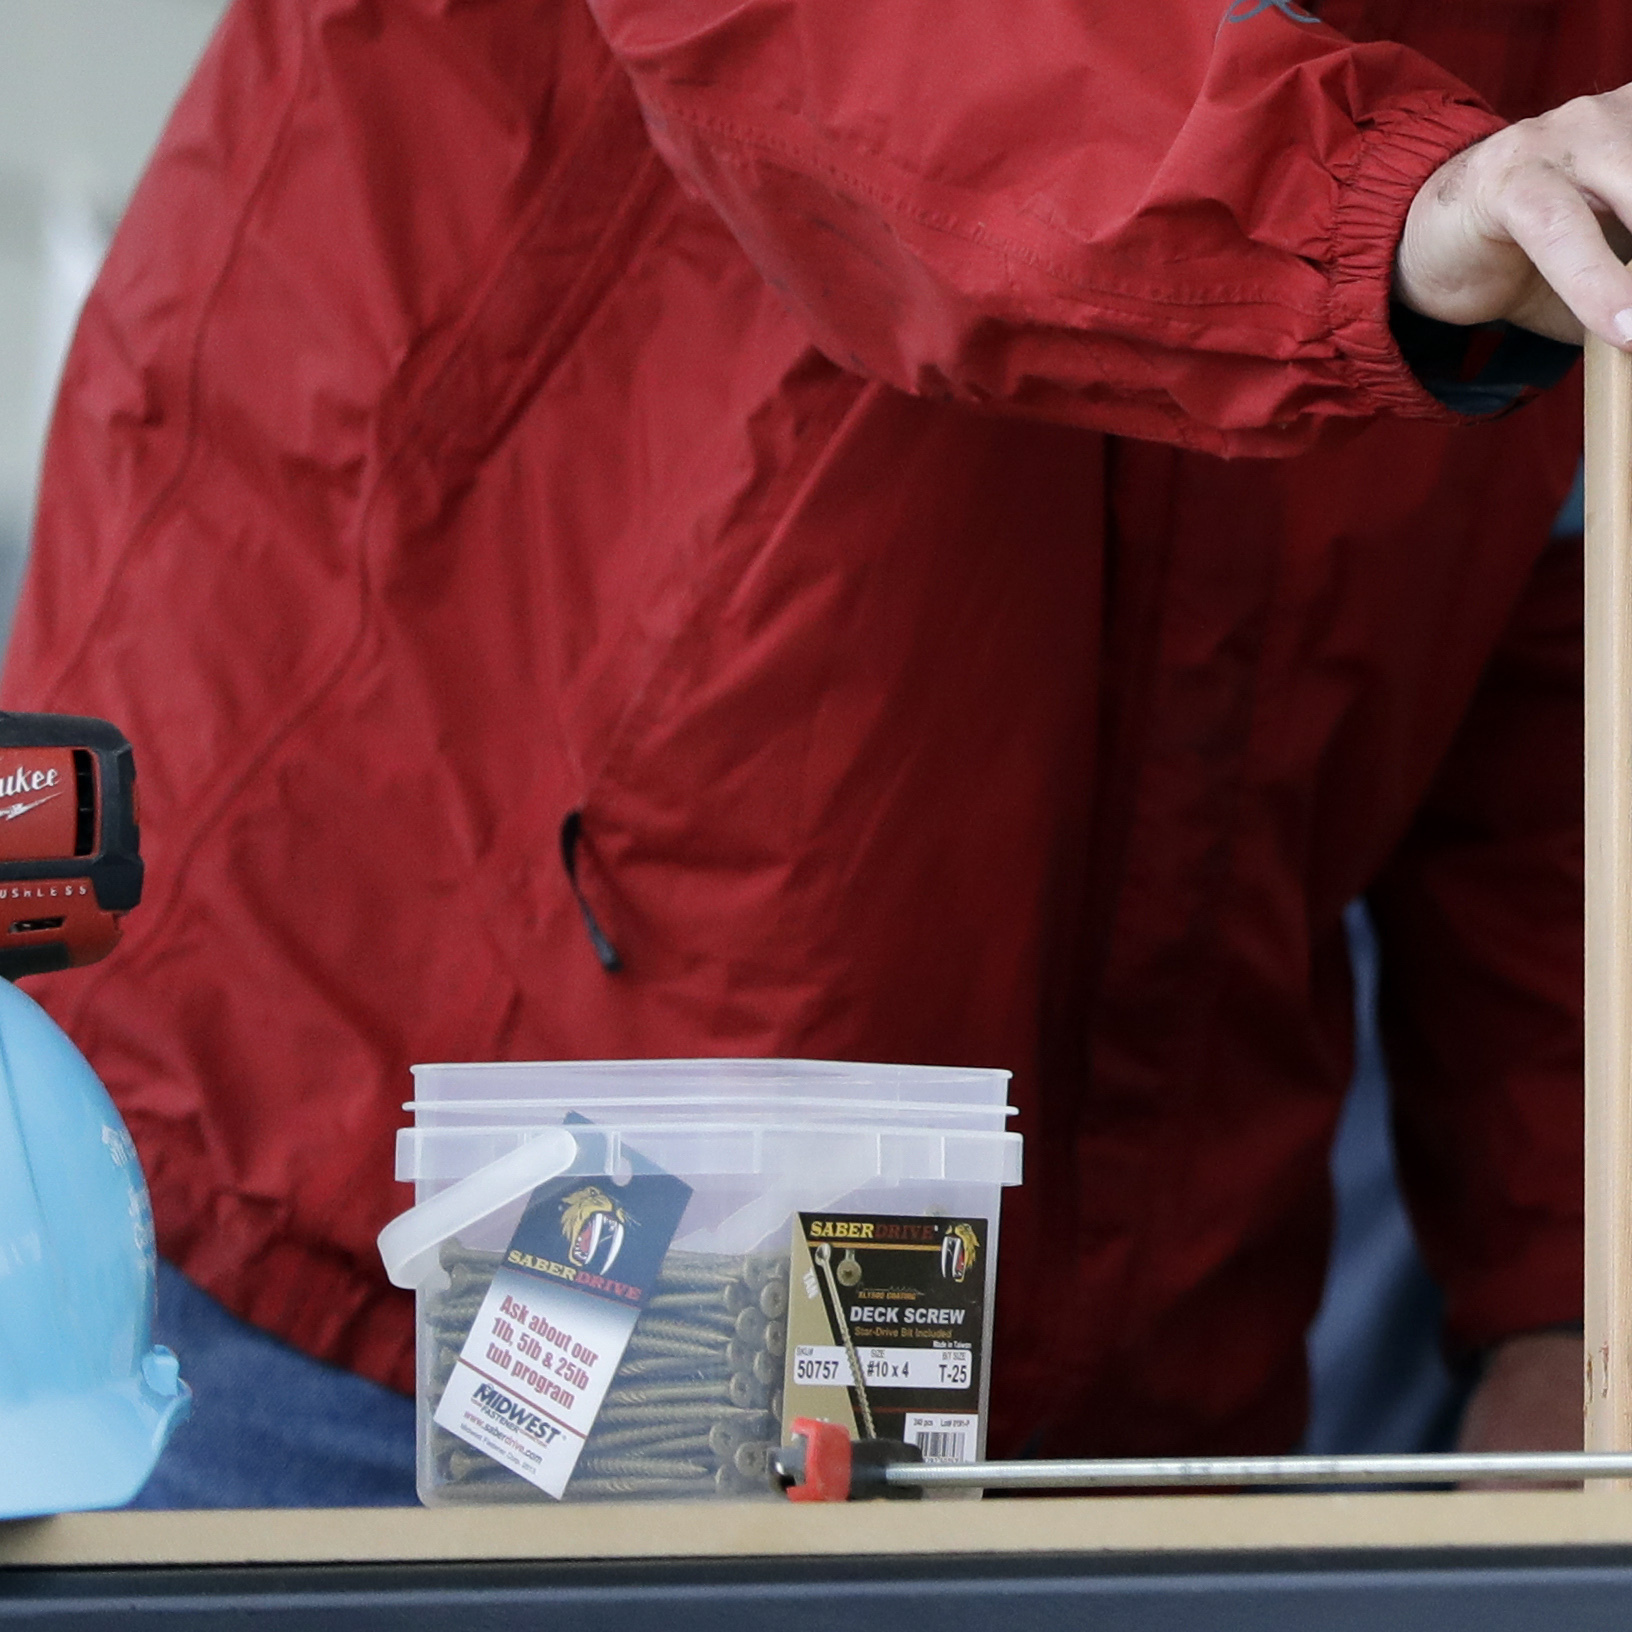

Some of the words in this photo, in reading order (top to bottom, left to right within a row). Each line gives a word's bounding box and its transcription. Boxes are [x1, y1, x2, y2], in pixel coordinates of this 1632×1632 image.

[810, 1221, 934, 1239] SABERDRIVE
[508, 1250, 642, 1300] SABERDRIVE
[500, 1295, 529, 1325] Ask
[528, 1315, 572, 1352] about
[571, 1342, 599, 1367] our
[850, 1306, 900, 1323] DECK
[904, 1308, 965, 1324] SCREW
[854, 1326, 899, 1338] Star-Drive
[901, 1327, 914, 1337] Bit
[915, 1328, 953, 1338] Included
[492, 1317, 514, 1346] 1lb,
[517, 1332, 542, 1361] 5lb
[542, 1352, 553, 1369] &
[554, 1357, 589, 1391] 25lb
[797, 1361, 839, 1380] 50757
[867, 1362, 887, 1377] #10
[892, 1365, 899, 1377] x
[902, 1361, 909, 1378] 4
[939, 1364, 967, 1384] T-25
[871, 1349, 885, 1358] SIZE
[953, 1352, 966, 1360] SIZE
[486, 1342, 512, 1370] tub
[511, 1360, 575, 1410] program
[472, 1383, 561, 1444] MIDWEST
[481, 1405, 518, 1433] FASTENER
[463, 1411, 543, 1465] www.saberdrive.com
